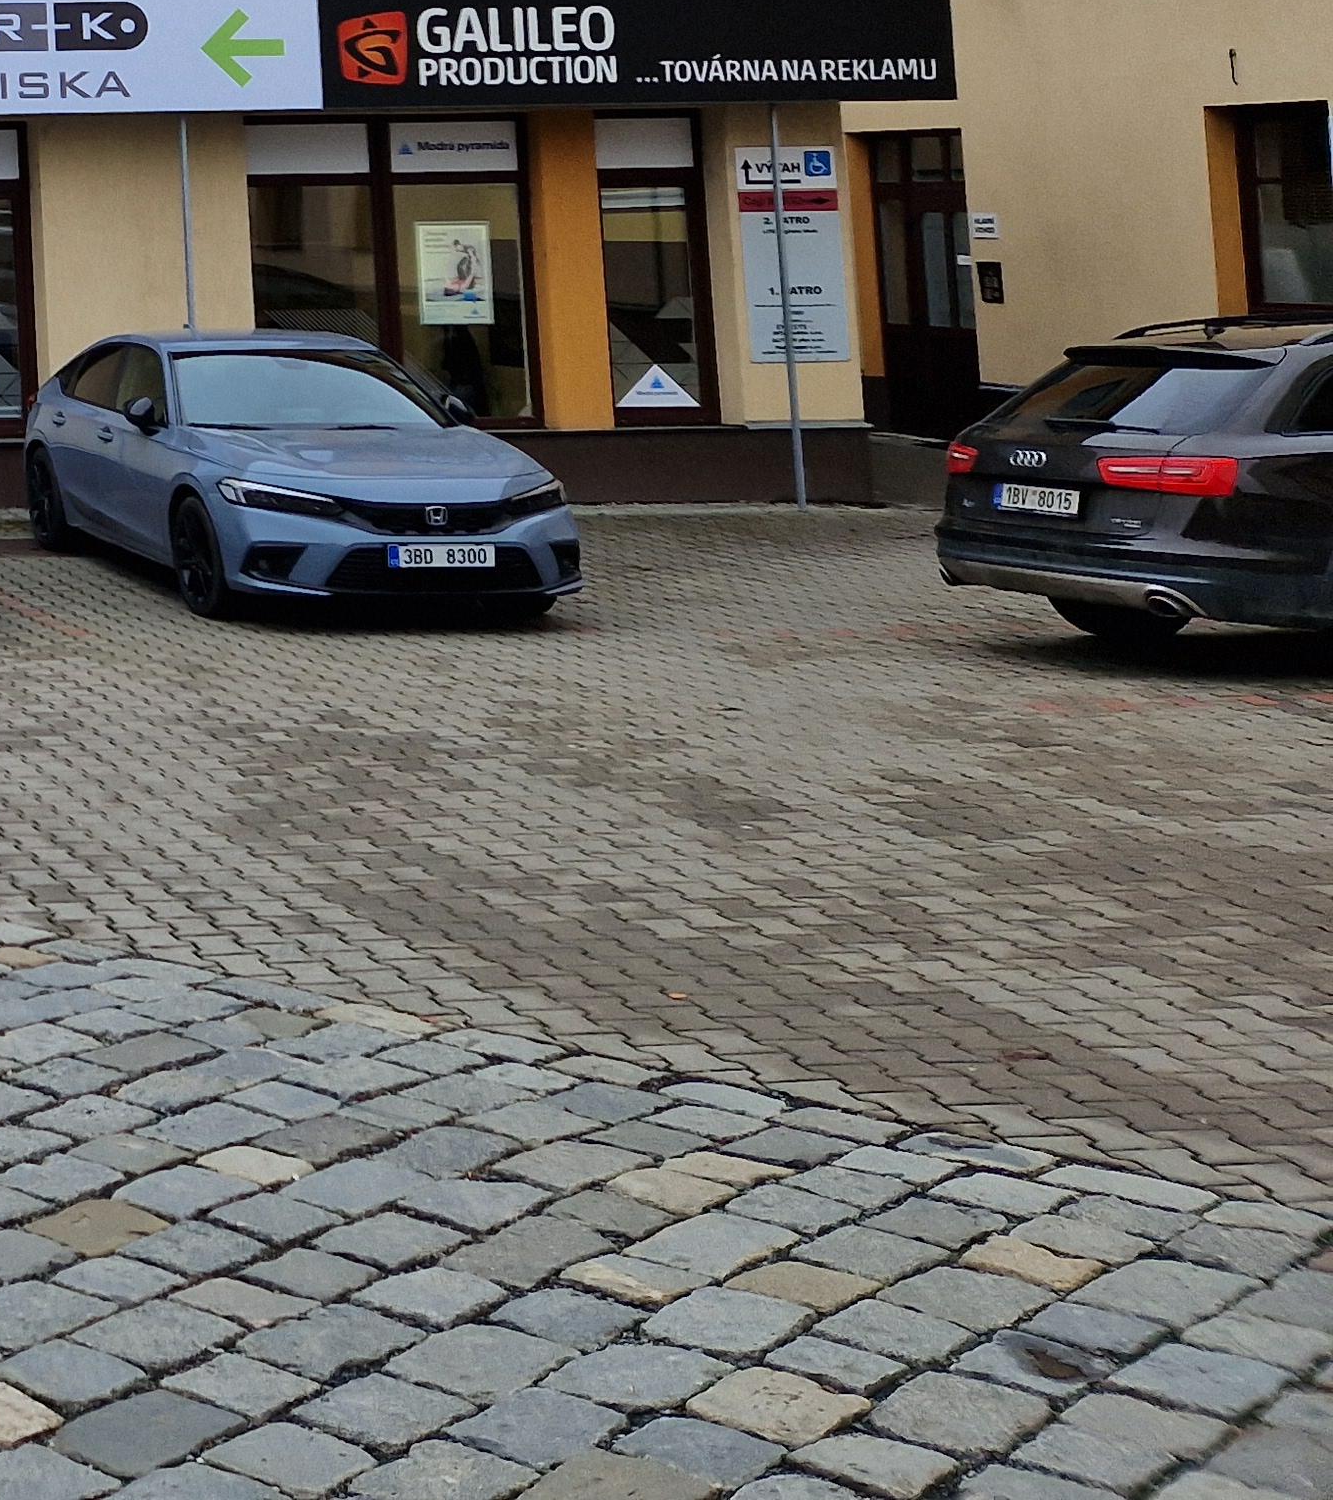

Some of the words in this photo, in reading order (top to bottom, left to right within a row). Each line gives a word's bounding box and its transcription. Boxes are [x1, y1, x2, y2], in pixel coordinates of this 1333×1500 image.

[416, 5, 615, 53] GALILEO
[417, 55, 618, 87] PRODUCTION
[782, 61, 818, 83] NA
[820, 57, 938, 83] REKLAMU
[457, 140, 510, 153] pyramida
[755, 160, 801, 174] VÝAH
[781, 216, 810, 225] ATRO
[788, 285, 823, 295] ATRO
[1006, 486, 1029, 506] 1BV
[1037, 491, 1073, 510] 8015
[403, 548, 434, 565] 3BD
[446, 548, 488, 565] 8300
